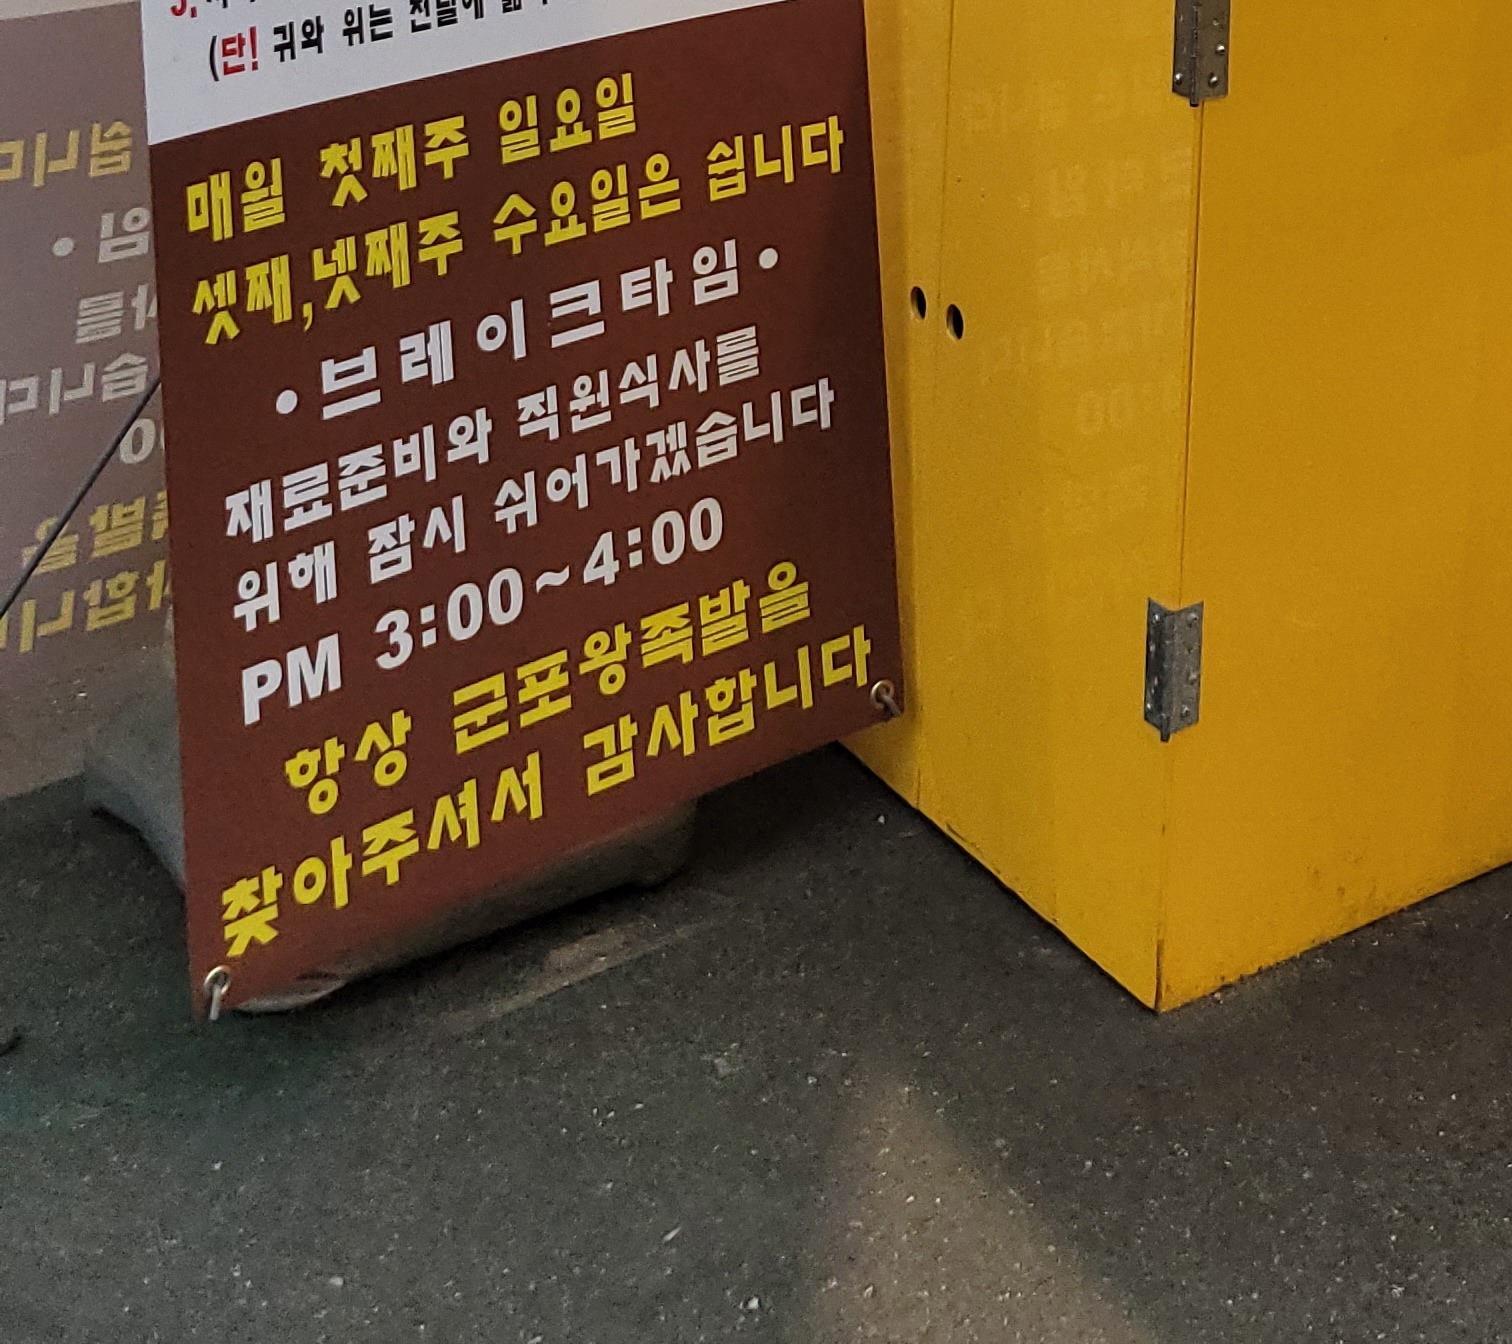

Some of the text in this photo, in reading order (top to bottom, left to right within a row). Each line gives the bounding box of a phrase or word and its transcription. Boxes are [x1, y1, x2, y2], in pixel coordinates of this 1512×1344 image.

[185, 156, 287, 243] 매월
[319, 113, 471, 209] 첫째주
[497, 71, 638, 166] 일요일
[208, 25, 259, 82] (단!
[273, 15, 324, 63] 귀와
[342, 3, 394, 47] 위는
[192, 210, 464, 346] 셋째,넷째주
[492, 152, 681, 256] 수요일은
[705, 115, 845, 203] 쉽니다
[224, 408, 493, 545] 재료준비와
[517, 325, 761, 442] 직원식사를
[232, 539, 338, 632] 위해
[367, 495, 466, 585] 잠시
[494, 377, 836, 535] 쉬어가겠습니다
[241, 497, 724, 726] PM 3:00~4:00
[284, 559, 812, 816] 항상 군포왕족발을
[221, 623, 873, 959] 찾아주셔서 감사합니다
